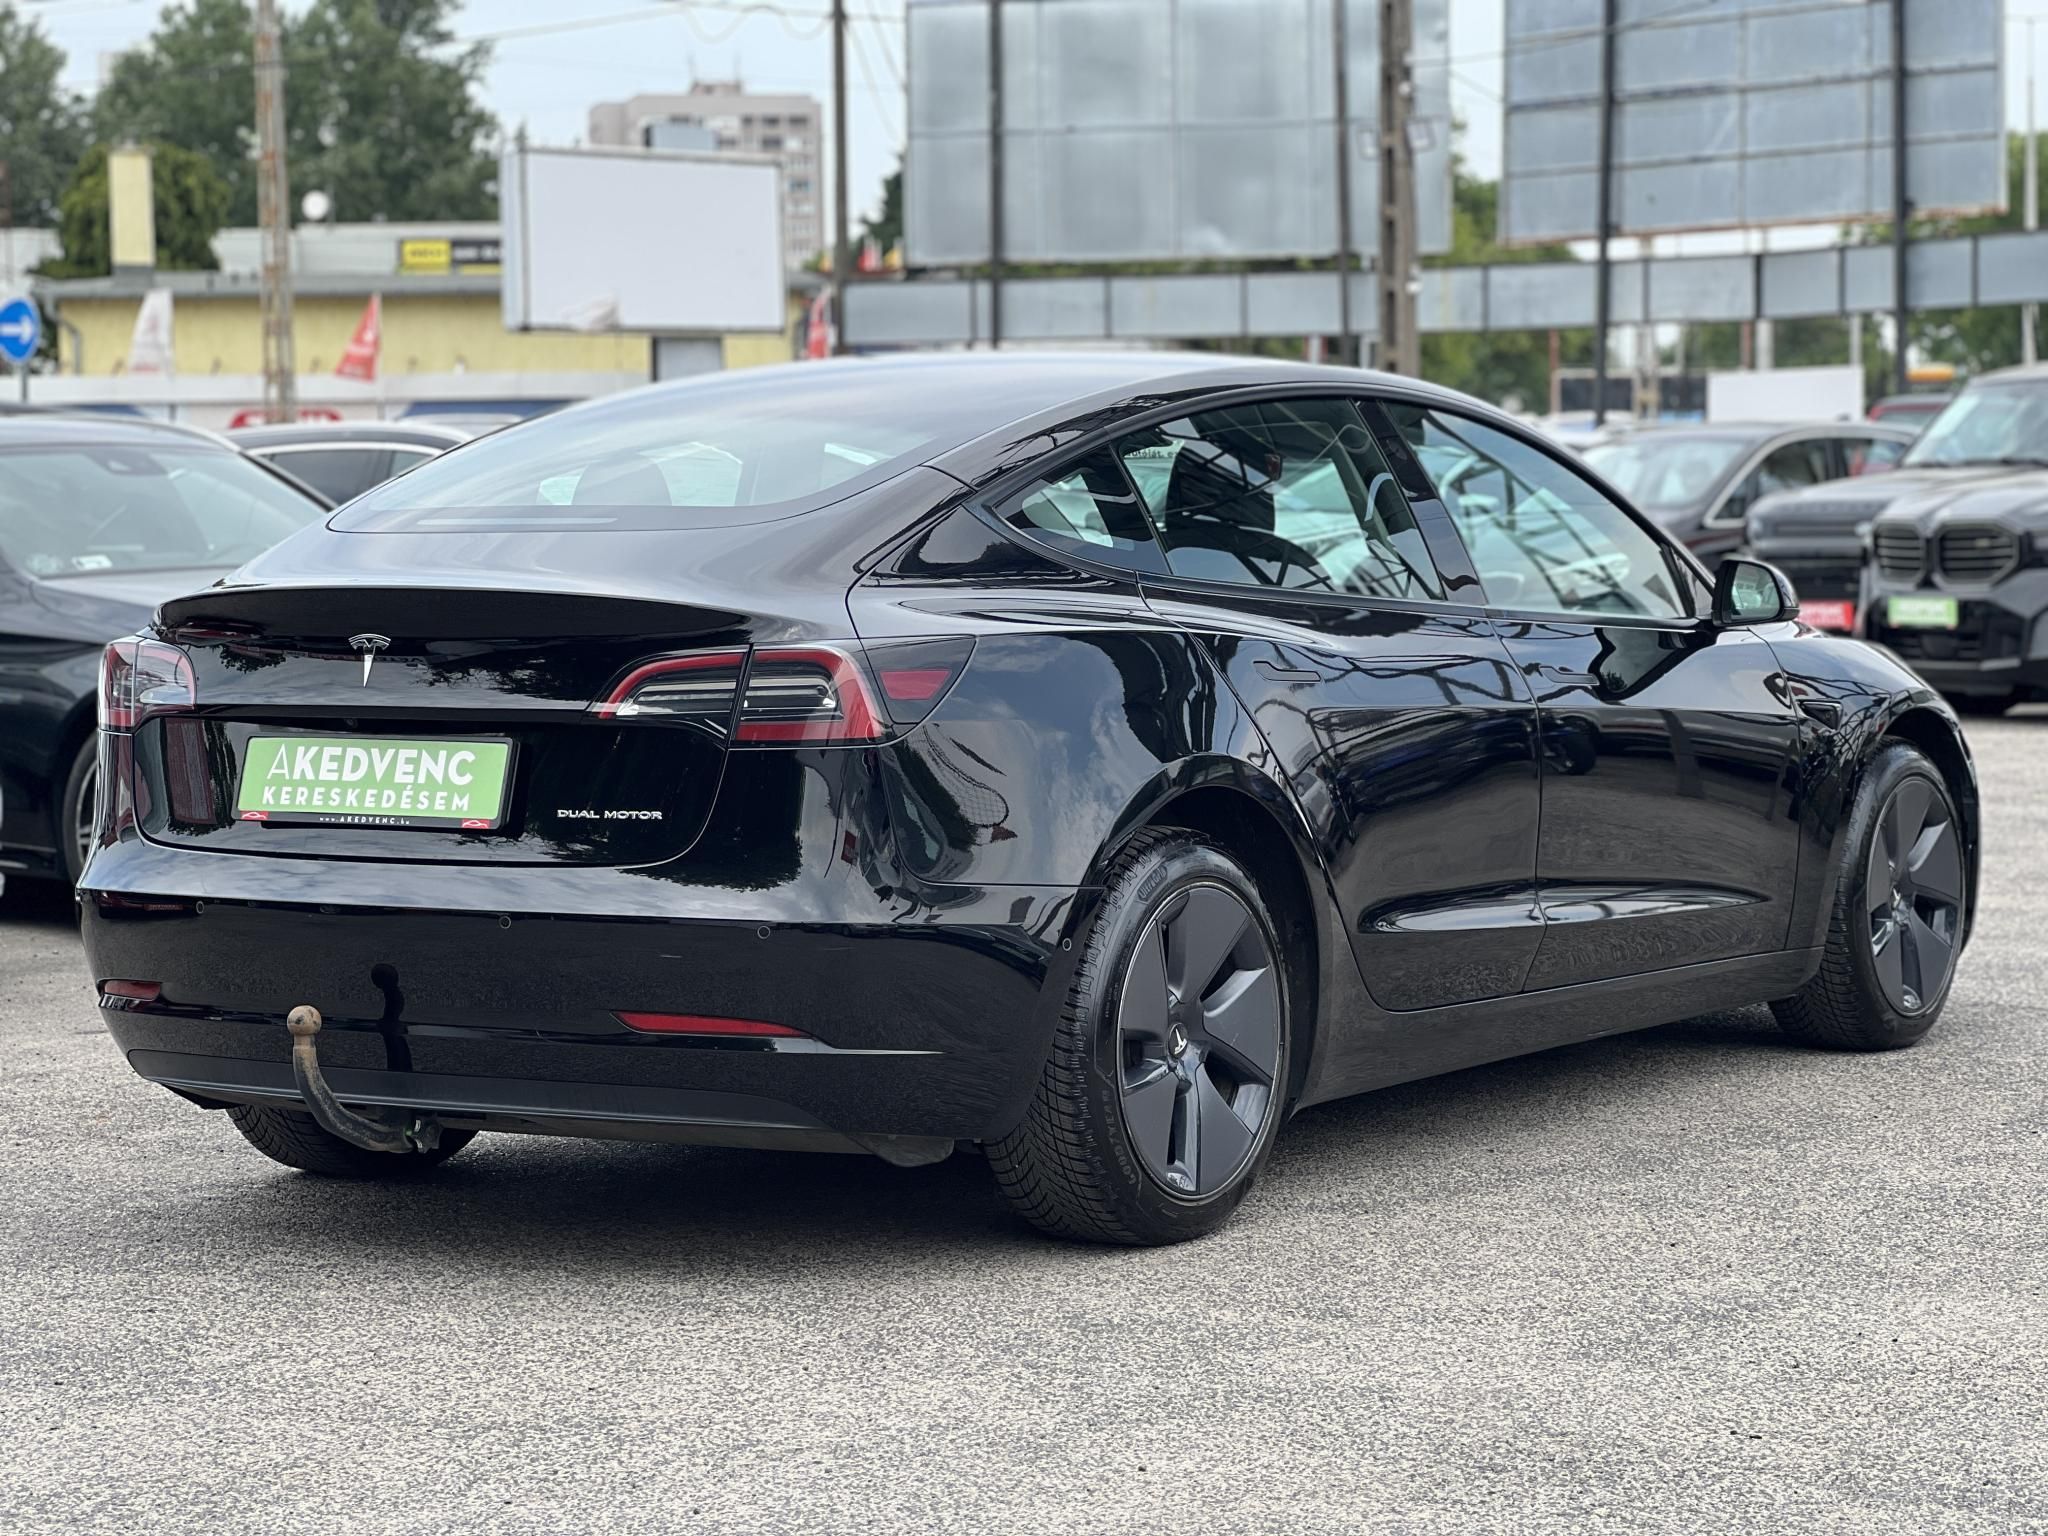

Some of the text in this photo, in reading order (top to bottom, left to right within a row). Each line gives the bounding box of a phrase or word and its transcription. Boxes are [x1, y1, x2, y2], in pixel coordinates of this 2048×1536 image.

[262, 785, 470, 812] KERESKEDÉSEM
[557, 809, 663, 820] DUAL MOTOR
